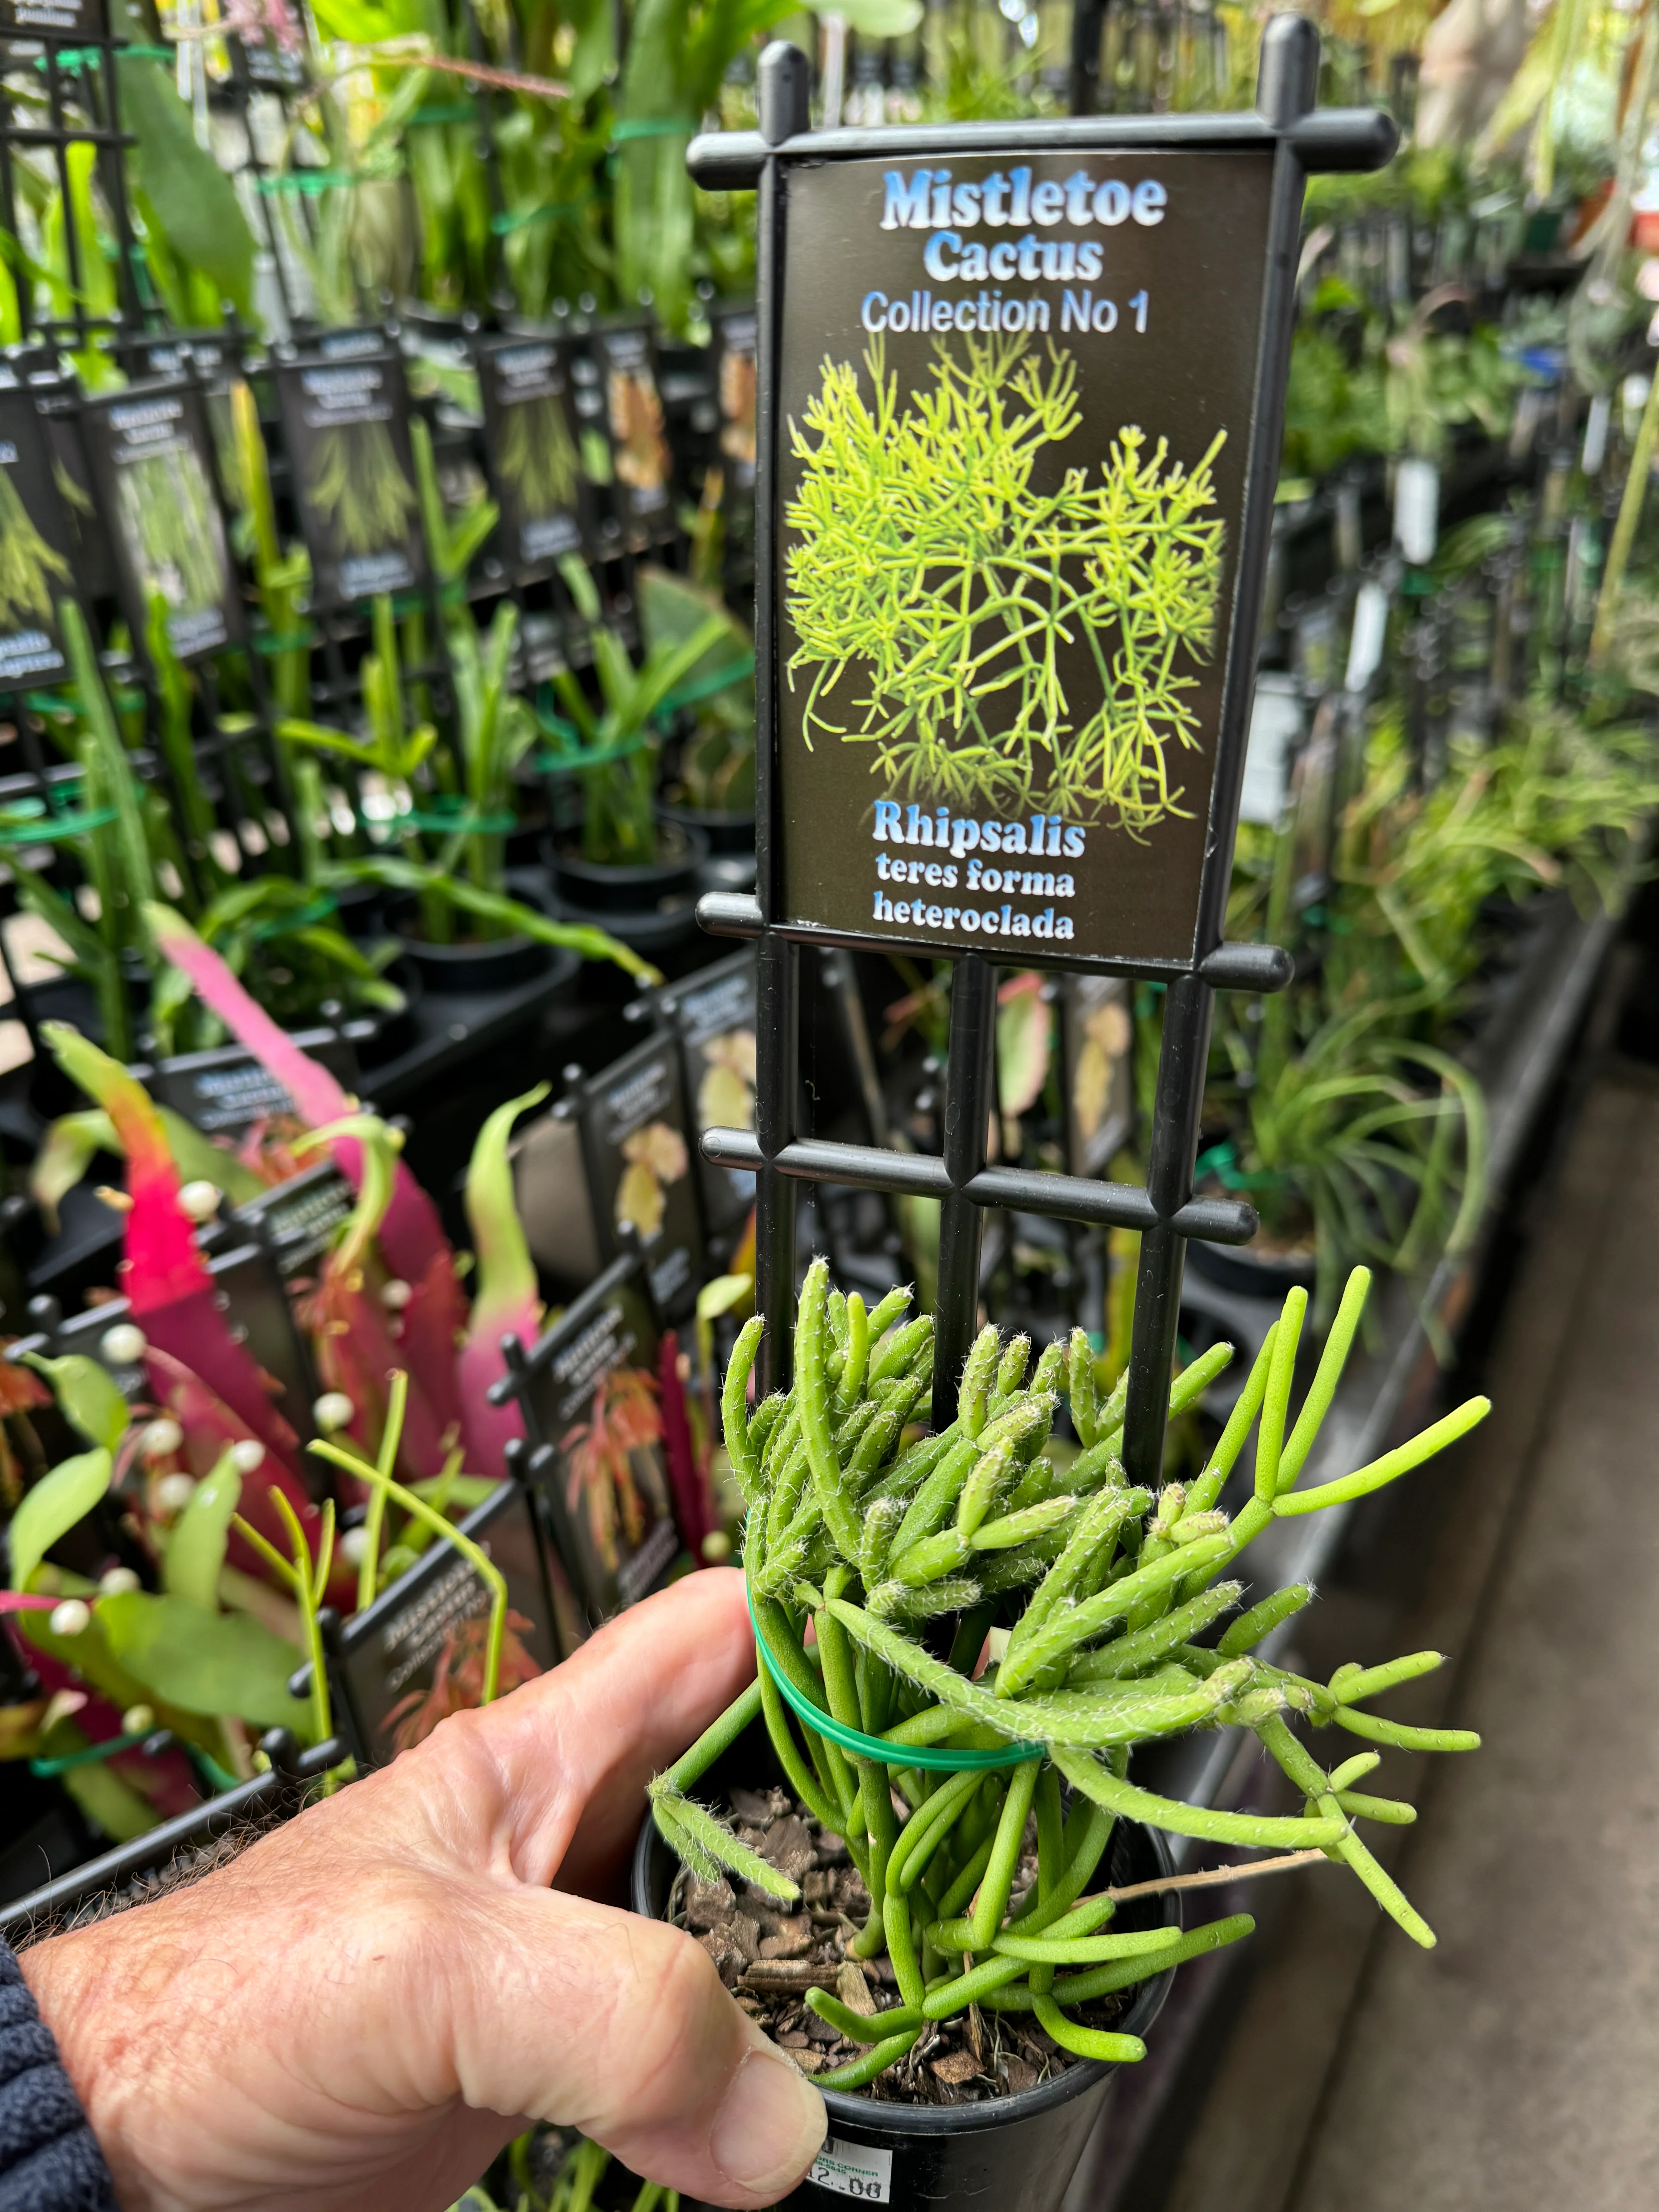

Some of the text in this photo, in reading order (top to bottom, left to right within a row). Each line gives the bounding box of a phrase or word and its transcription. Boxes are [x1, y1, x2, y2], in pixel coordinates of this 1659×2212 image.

[879, 165, 1167, 230] Mistletoe
[923, 230, 1104, 282] Cactus
[862, 289, 1149, 333] Collection No 1
[872, 800, 1086, 859] Rhipsalis
[875, 852, 1076, 898] teres forma
[872, 891, 1075, 940] heteroclada
[837, 2163, 878, 2177] CORNER
